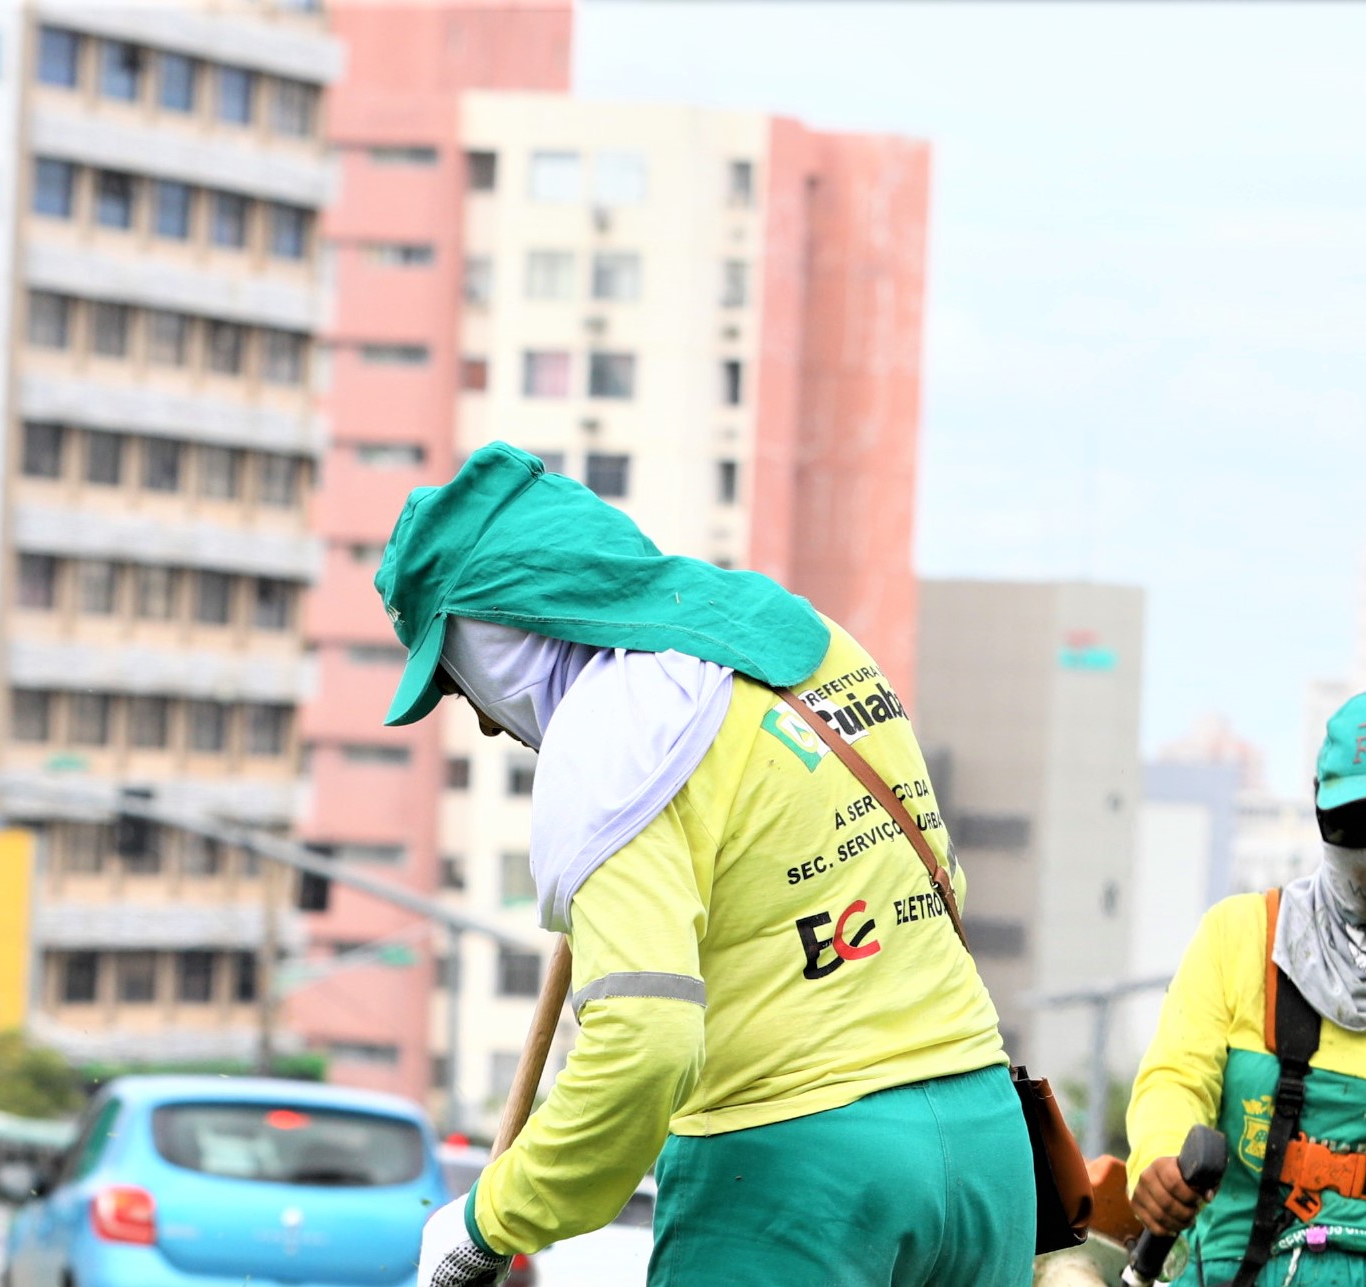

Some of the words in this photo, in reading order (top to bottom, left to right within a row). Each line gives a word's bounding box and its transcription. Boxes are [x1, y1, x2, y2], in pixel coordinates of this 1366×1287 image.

[815, 682, 910, 736] Cuiab
[914, 779, 930, 798] DA
[787, 855, 834, 885] SEC.
[837, 819, 904, 863] SERVIÇO
[893, 891, 948, 925] ELETRO
